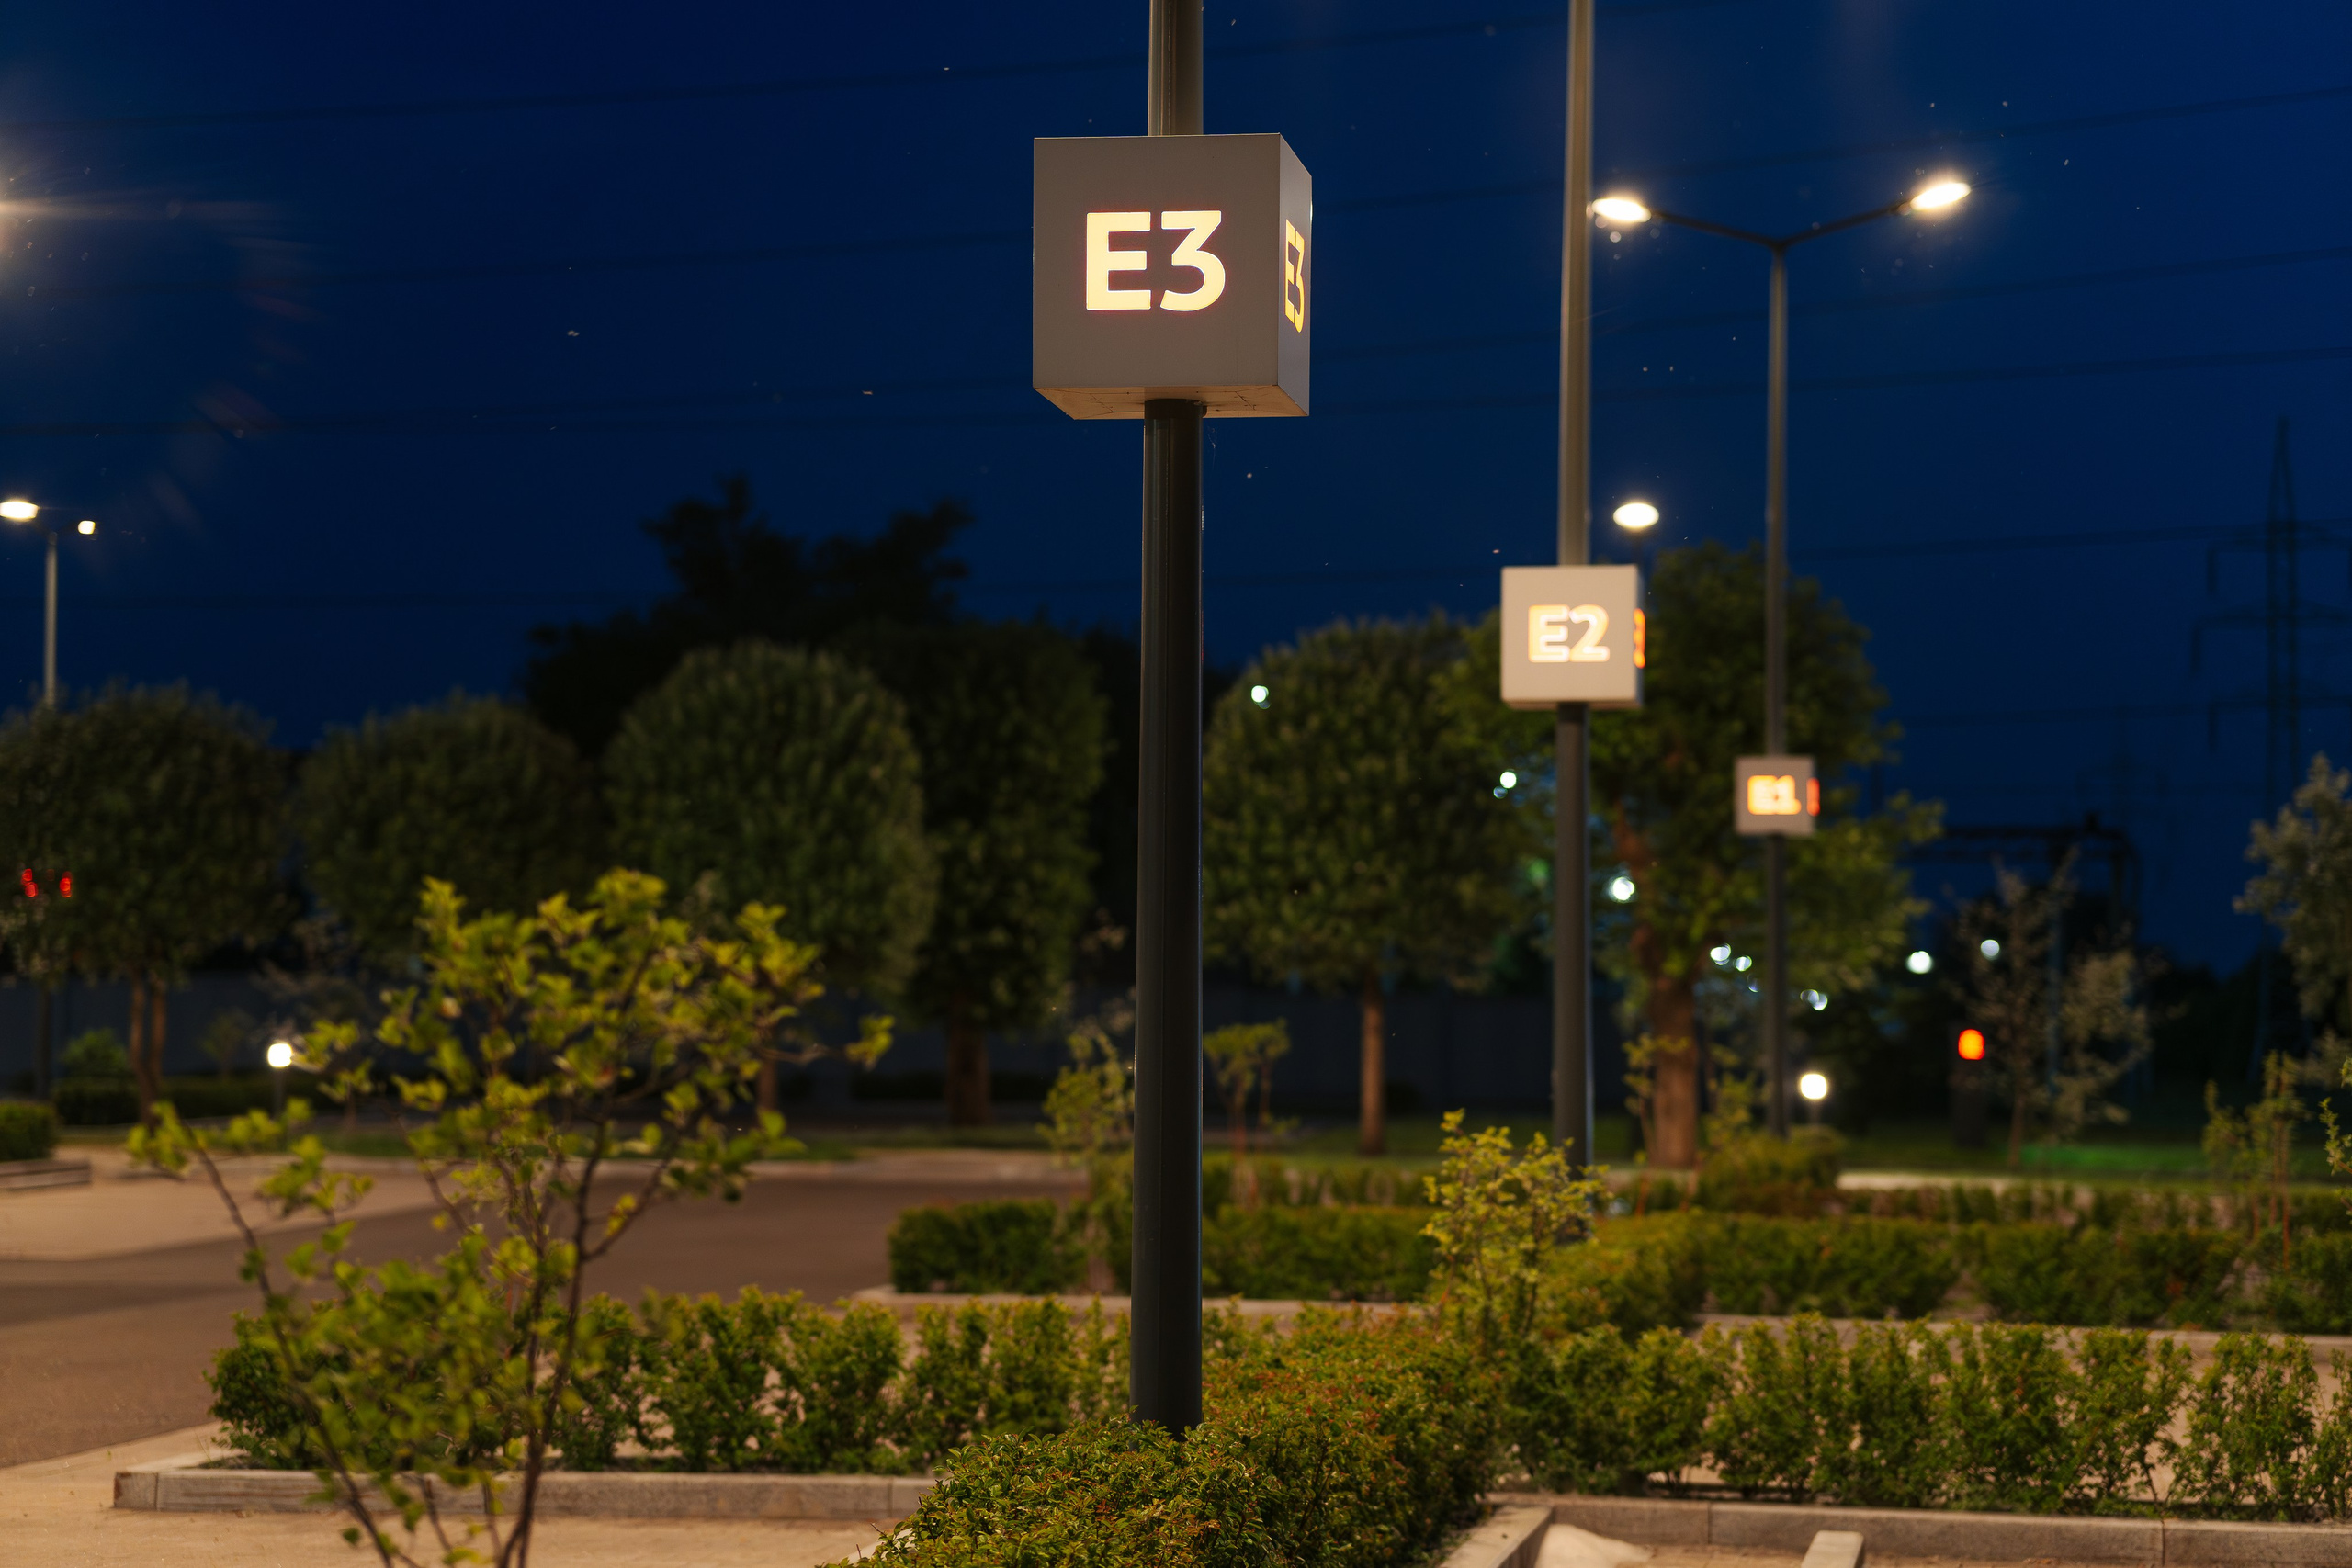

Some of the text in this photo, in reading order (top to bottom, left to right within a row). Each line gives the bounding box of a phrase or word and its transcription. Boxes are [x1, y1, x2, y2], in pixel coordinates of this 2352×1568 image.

[1086, 210, 1226, 311] E3
[1285, 219, 1305, 333] E3
[1528, 604, 1610, 663] E2
[1747, 775, 1802, 816] E1
